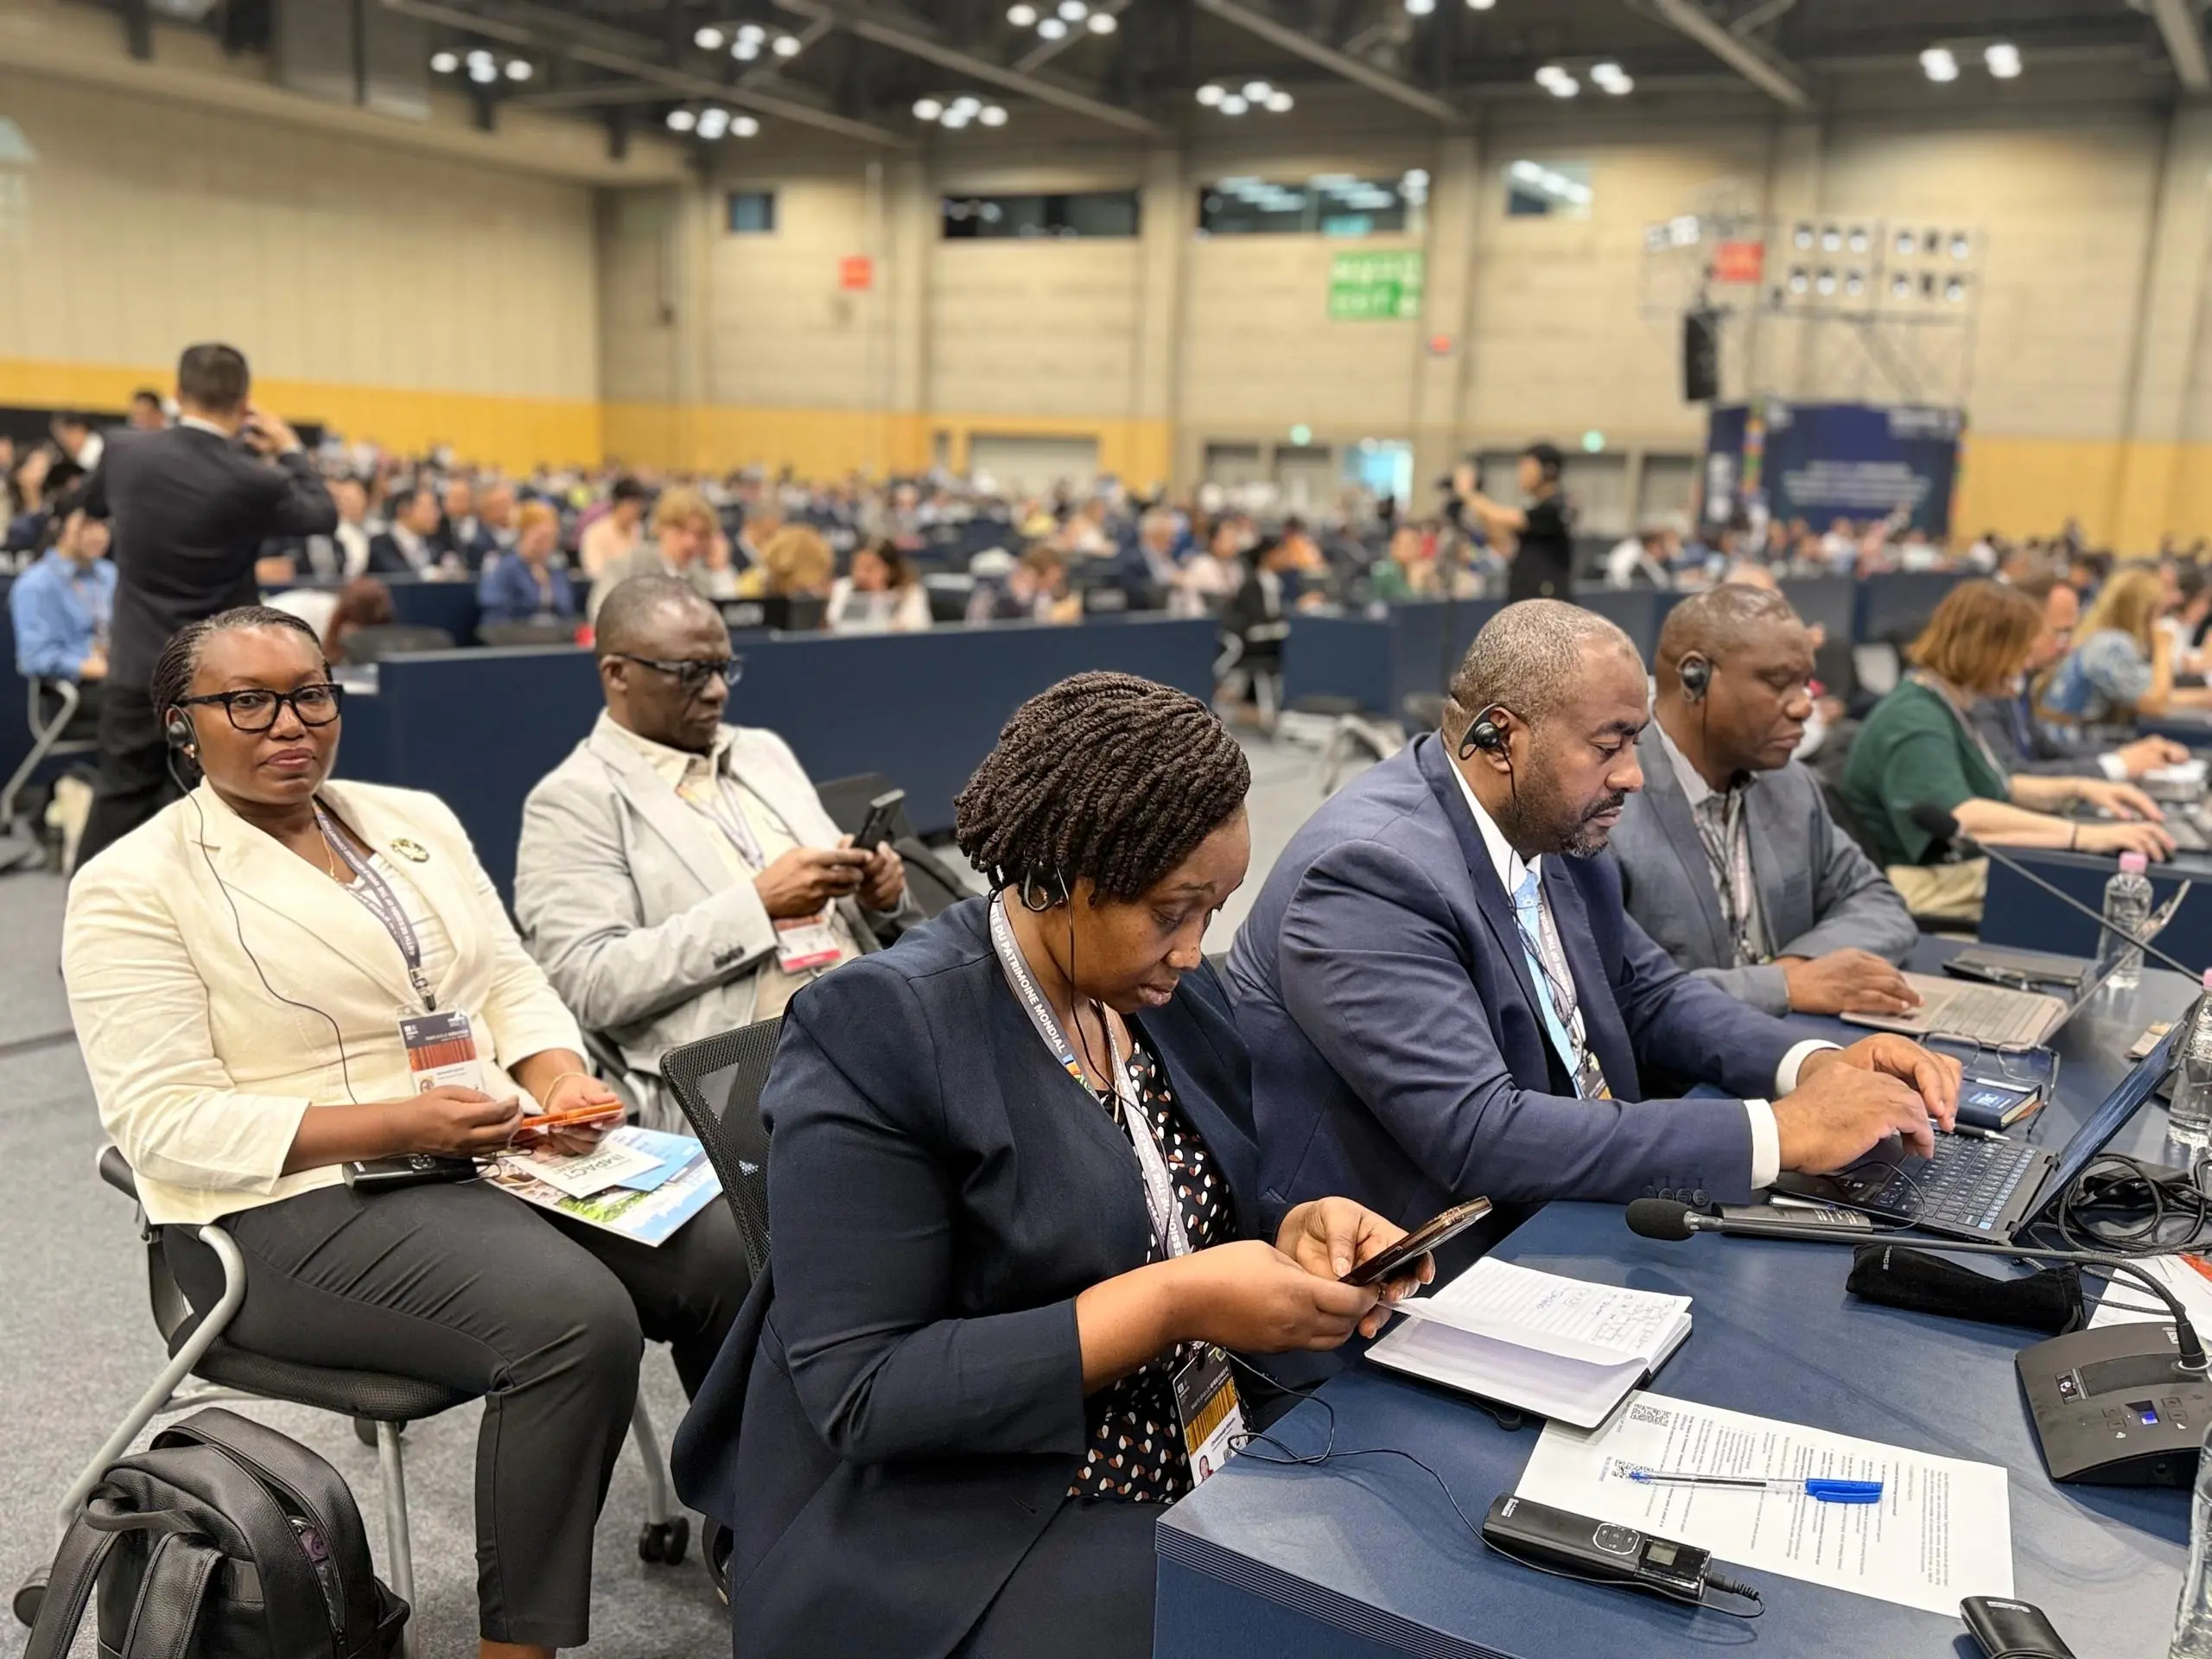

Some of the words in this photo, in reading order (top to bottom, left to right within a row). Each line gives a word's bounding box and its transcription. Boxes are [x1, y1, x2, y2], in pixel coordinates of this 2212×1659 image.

[1537, 905, 1550, 934] WORLD
[1546, 934, 1556, 950] THE
[1551, 950, 1560, 963] OF
[994, 925, 1006, 942] DU
[1000, 941, 1039, 1006] PATRIMOINE
[1033, 1003, 1066, 1054] MONDIAL
[1138, 1132, 1158, 1171] WORLD
[562, 1154, 625, 1180] IMPACT
[1152, 1173, 1167, 1197] THE
[1160, 1194, 1172, 1212] OF
[1166, 1214, 1184, 1256] ESSION
